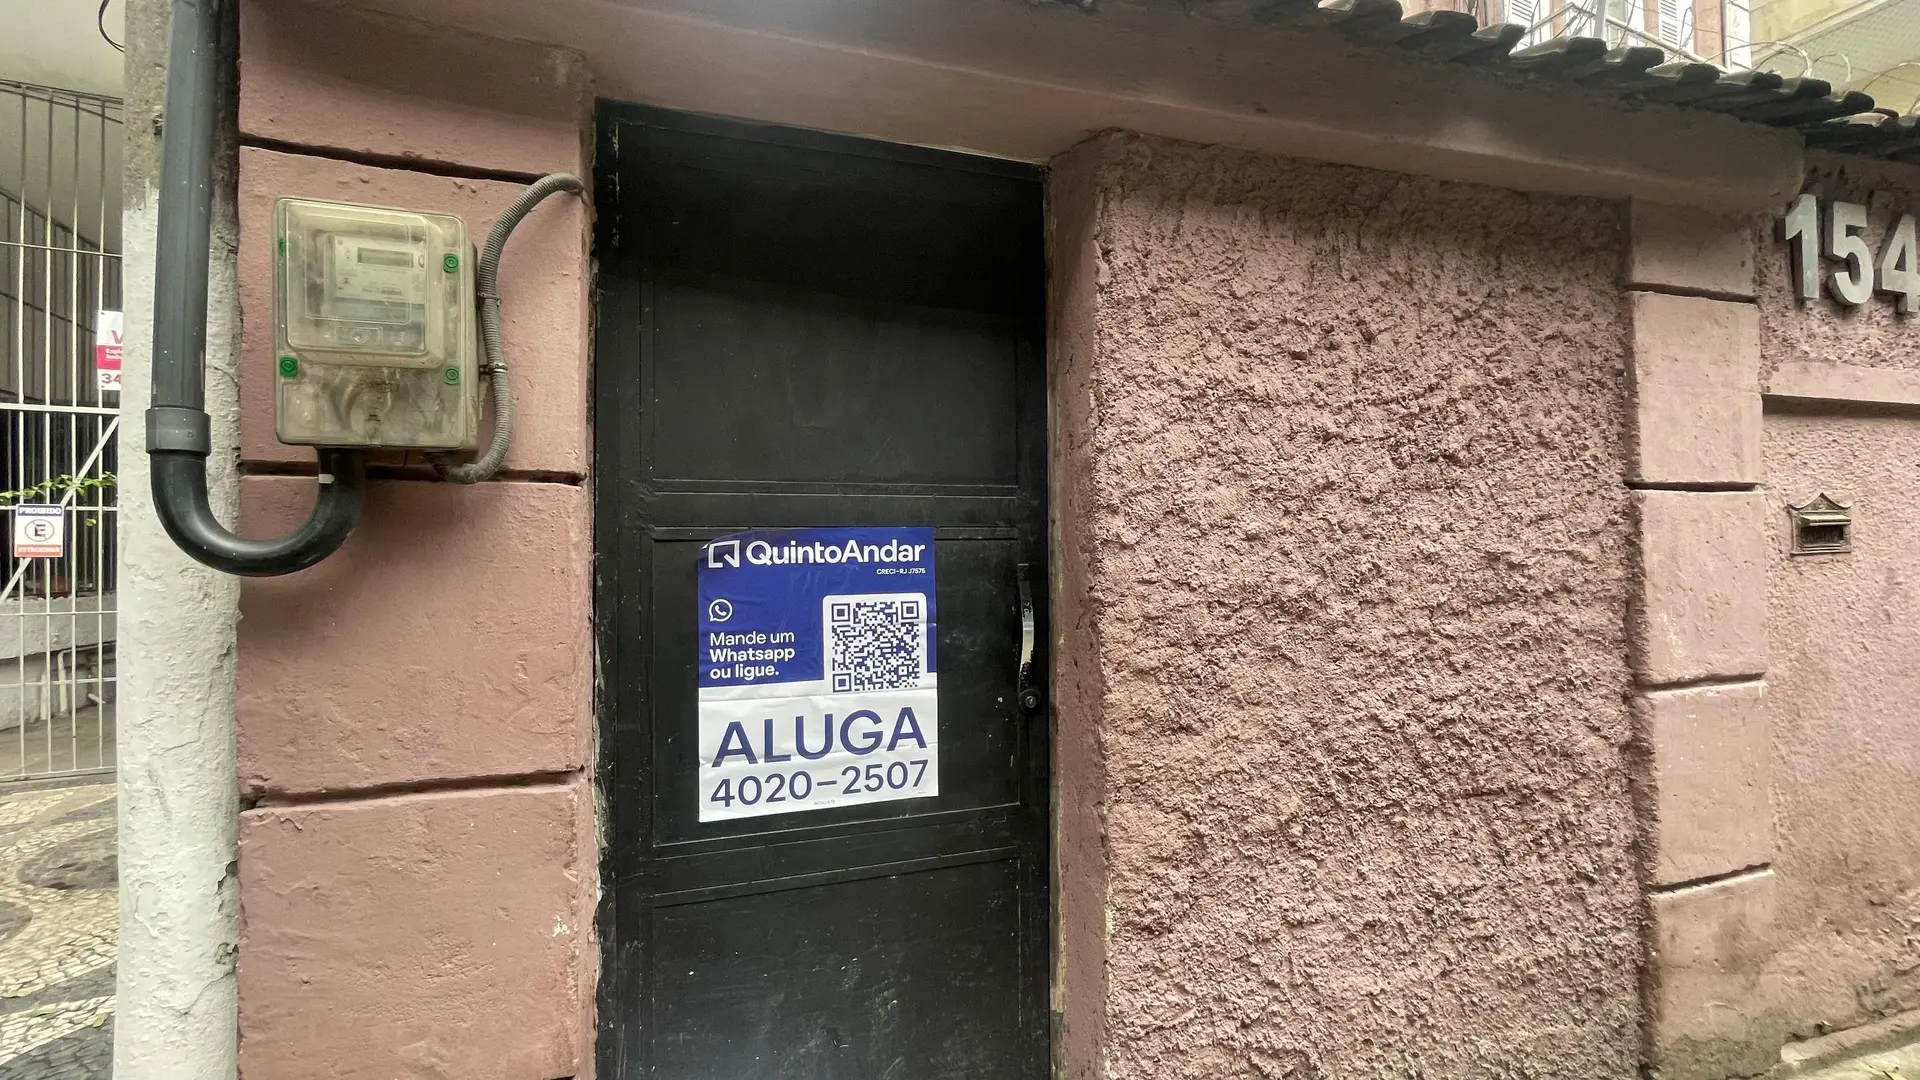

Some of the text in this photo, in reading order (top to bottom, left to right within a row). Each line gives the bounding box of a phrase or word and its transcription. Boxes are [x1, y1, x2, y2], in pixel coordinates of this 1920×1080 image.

[1785, 194, 1920, 312] 154
[19, 507, 62, 515] PROIBIDO
[746, 539, 925, 566] QuintoAndar
[710, 631, 795, 646] Mande um
[709, 647, 795, 663] Whatsapp
[710, 663, 780, 681] ou ligue.
[711, 707, 928, 768] ALUGA
[710, 759, 929, 807] 4020-2507
